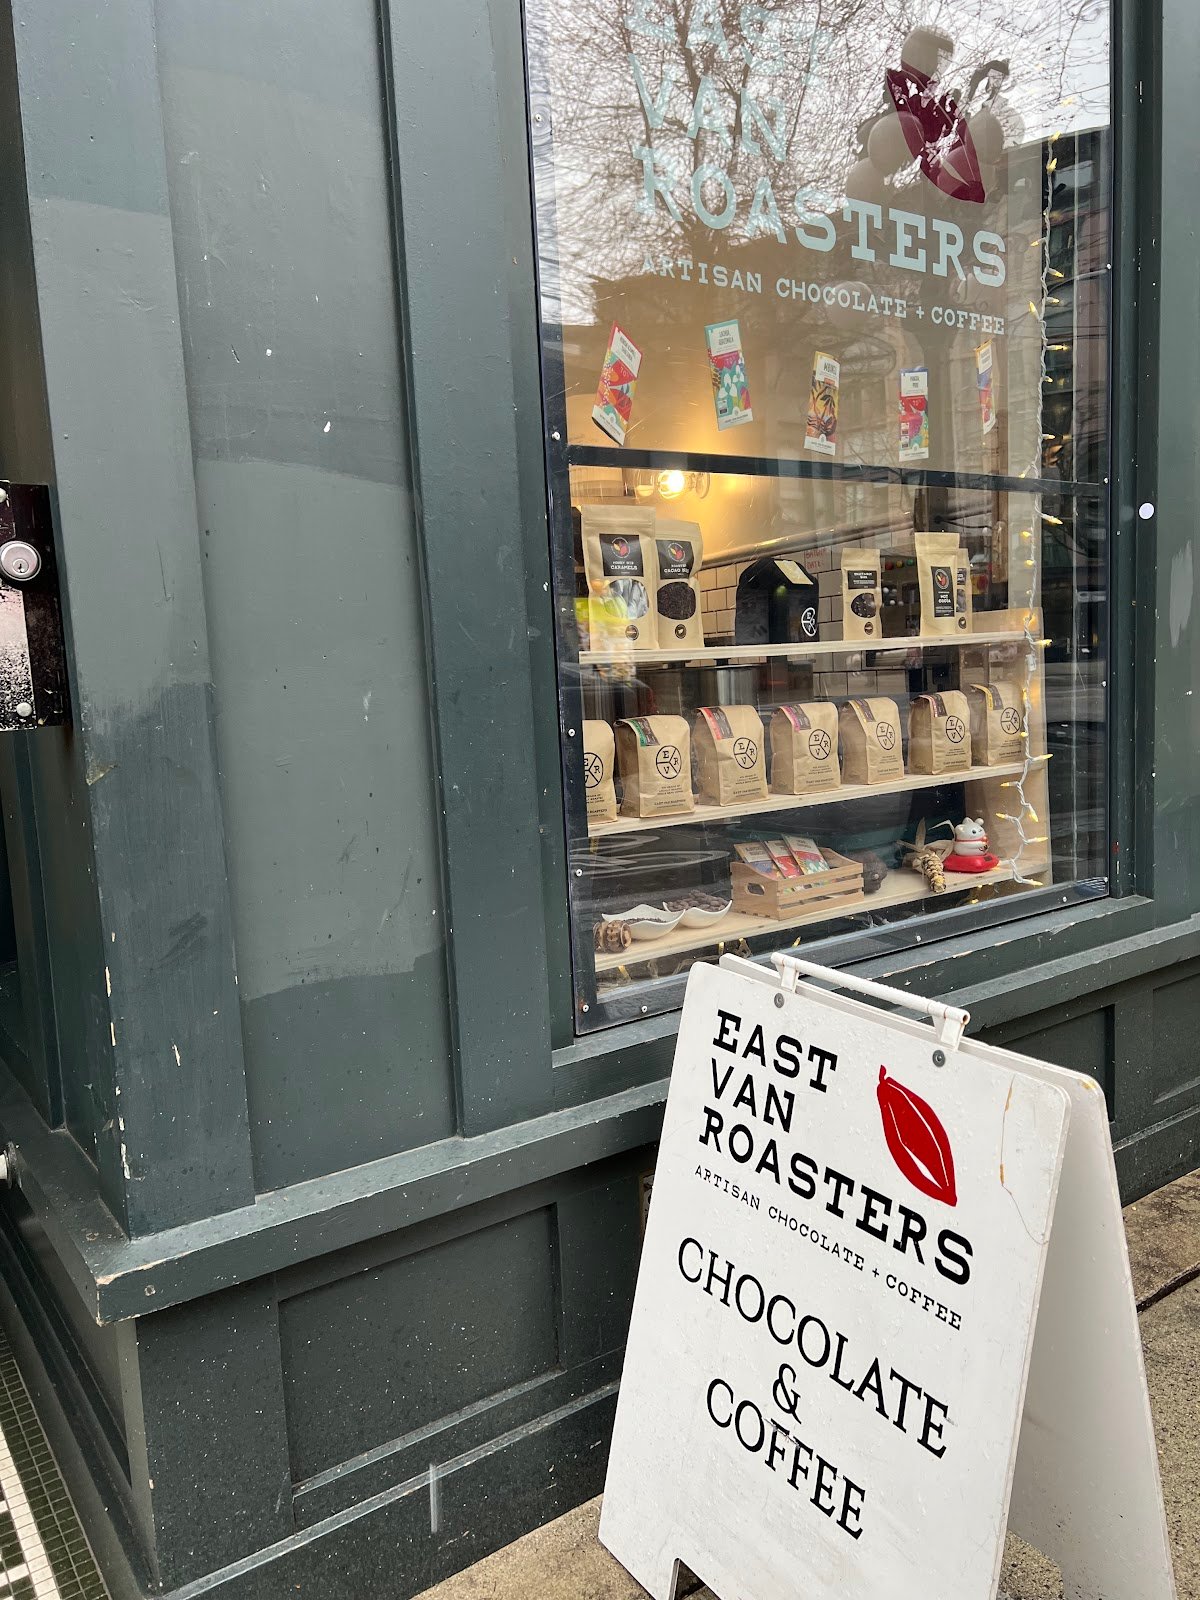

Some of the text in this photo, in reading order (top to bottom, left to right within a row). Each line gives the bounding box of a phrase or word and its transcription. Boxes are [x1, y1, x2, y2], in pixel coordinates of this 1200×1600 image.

[628, 53, 789, 163] VAN
[632, 145, 1008, 288] ROASTERS
[641, 255, 763, 294] ARTISAN
[776, 278, 908, 319] CHOCOLATE
[931, 306, 1005, 335] COFFEE
[711, 1057, 796, 1134] VAN
[712, 1009, 838, 1093] EAST
[695, 1164, 761, 1211] ARTISAN
[768, 1206, 864, 1271] CHOCOLATE
[886, 1273, 962, 1331] COFFEE
[698, 1105, 974, 1286] ROASTERS
[678, 1237, 950, 1460] CHOCOLATE
[772, 1363, 802, 1425] &
[706, 1378, 866, 1541] COFFEE
